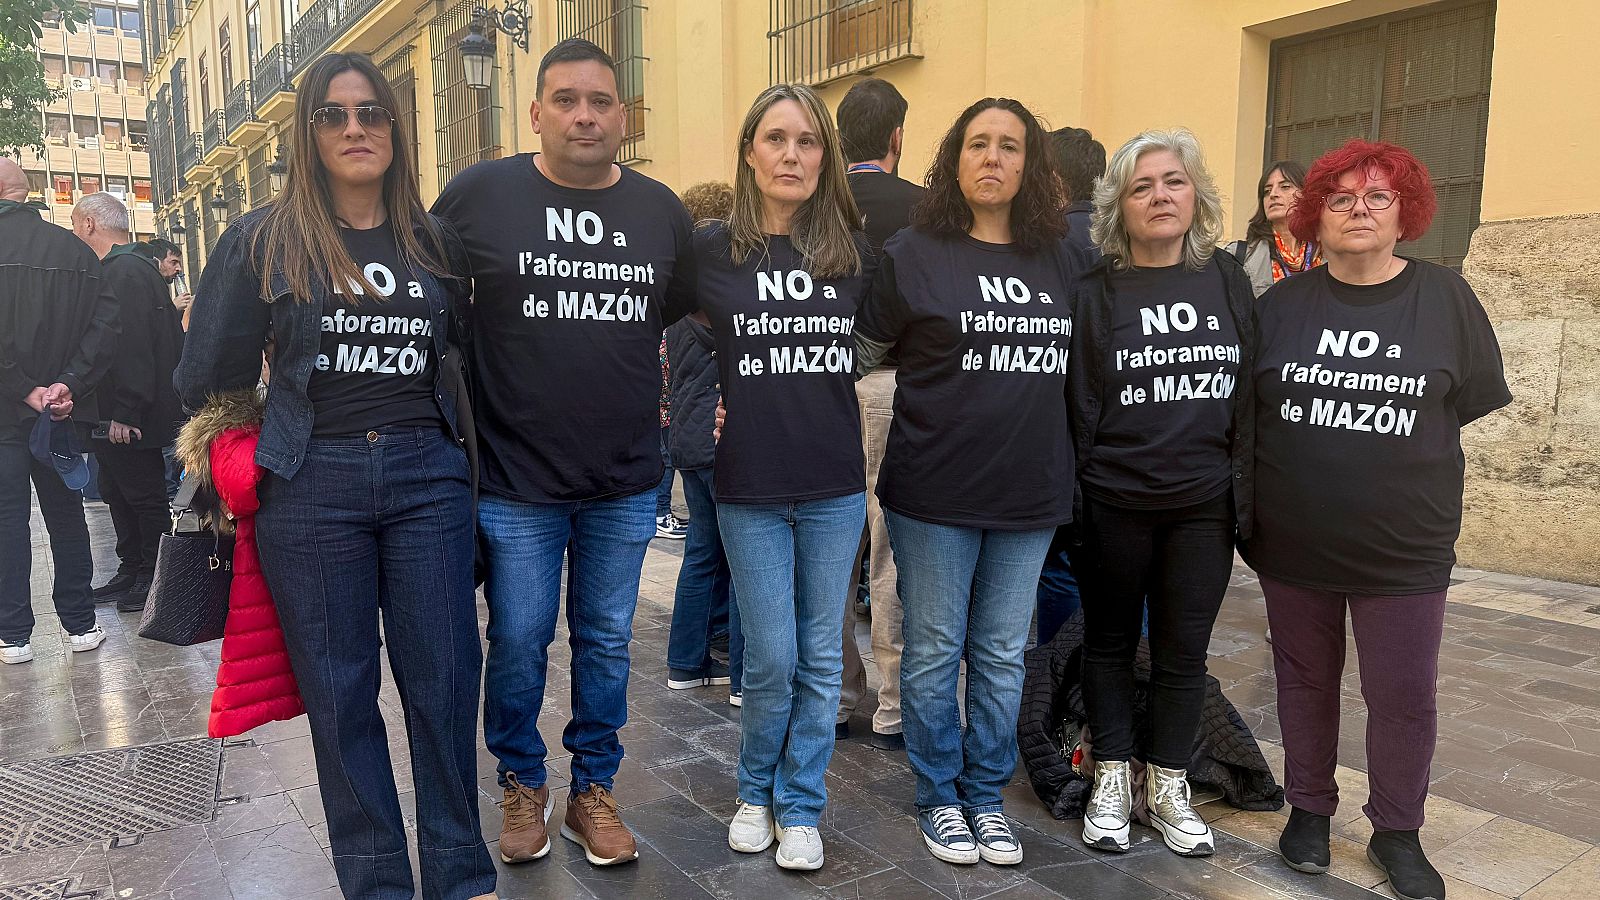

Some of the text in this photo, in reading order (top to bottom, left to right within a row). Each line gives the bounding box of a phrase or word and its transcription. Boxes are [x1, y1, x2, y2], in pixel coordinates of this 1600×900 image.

[545, 207, 627, 247] NO a
[518, 251, 655, 285] l'aforament
[756, 269, 838, 301] NO a
[407, 280, 424, 298] a
[522, 288, 648, 322] de MAZÓN
[977, 275, 1053, 304] NO a
[320, 308, 433, 337] aforamen
[732, 312, 855, 337] l'aforament
[960, 310, 1072, 337] l'aforament
[1139, 302, 1220, 336] NO a
[314, 341, 428, 376] e MAZÓN
[738, 340, 853, 377] de MAZÓN
[961, 340, 1069, 375] de MAZÓN
[1116, 344, 1240, 371] l'aforament
[1316, 328, 1402, 359] NO a
[1120, 367, 1236, 406] de MAZÓN
[1281, 362, 1427, 398] l'aforament
[1280, 397, 1418, 437] de MAZÓN
